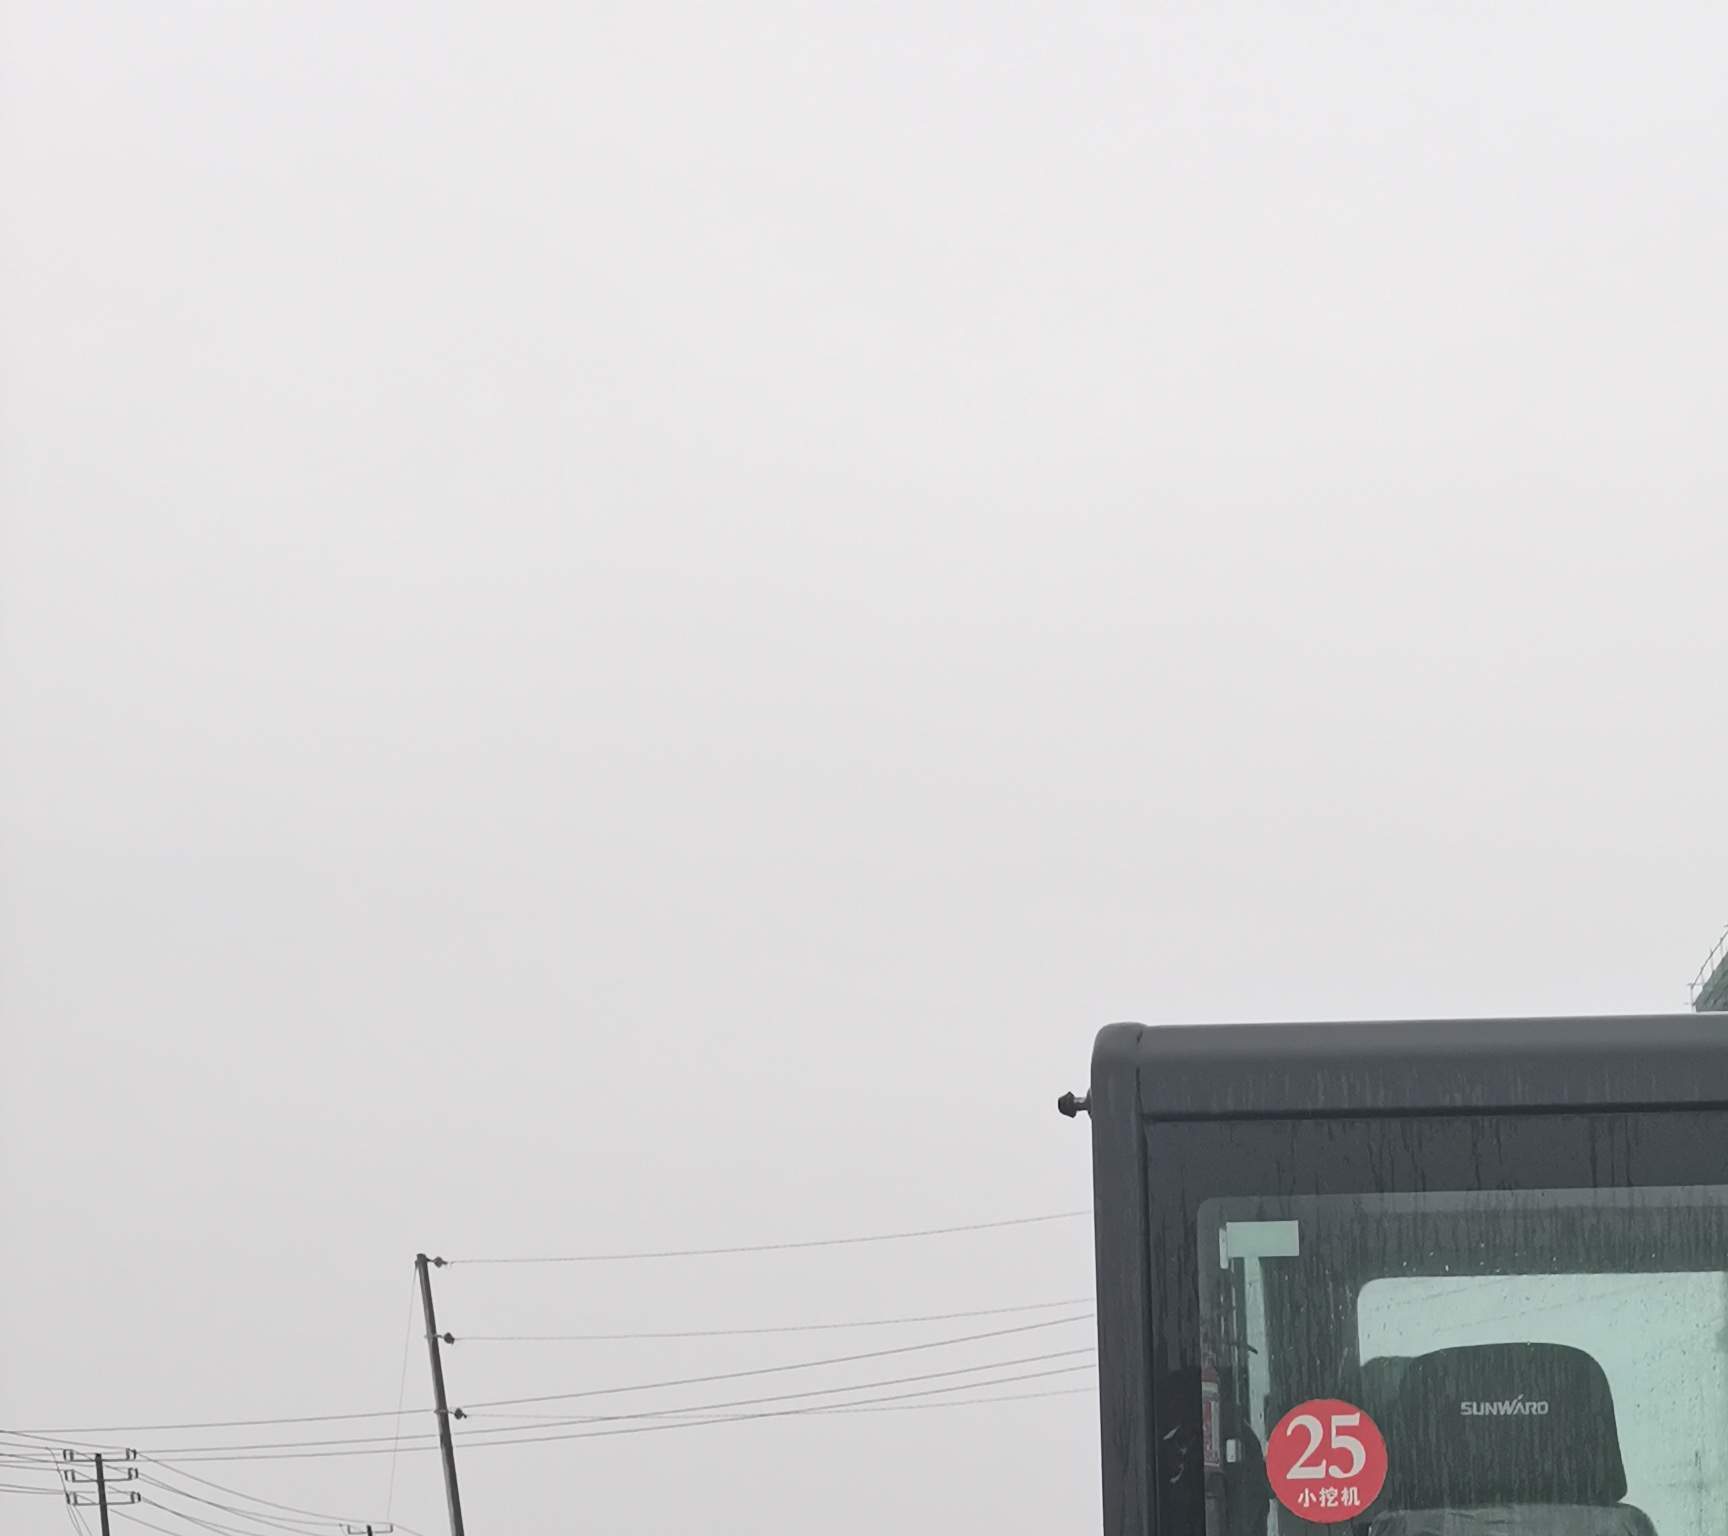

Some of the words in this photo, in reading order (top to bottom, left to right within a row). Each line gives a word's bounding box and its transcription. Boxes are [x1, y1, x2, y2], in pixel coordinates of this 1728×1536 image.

[1460, 1395, 1550, 1416] SUNWARD
[1286, 1412, 1366, 1480] 25
[1298, 1486, 1361, 1508] 小挖机
